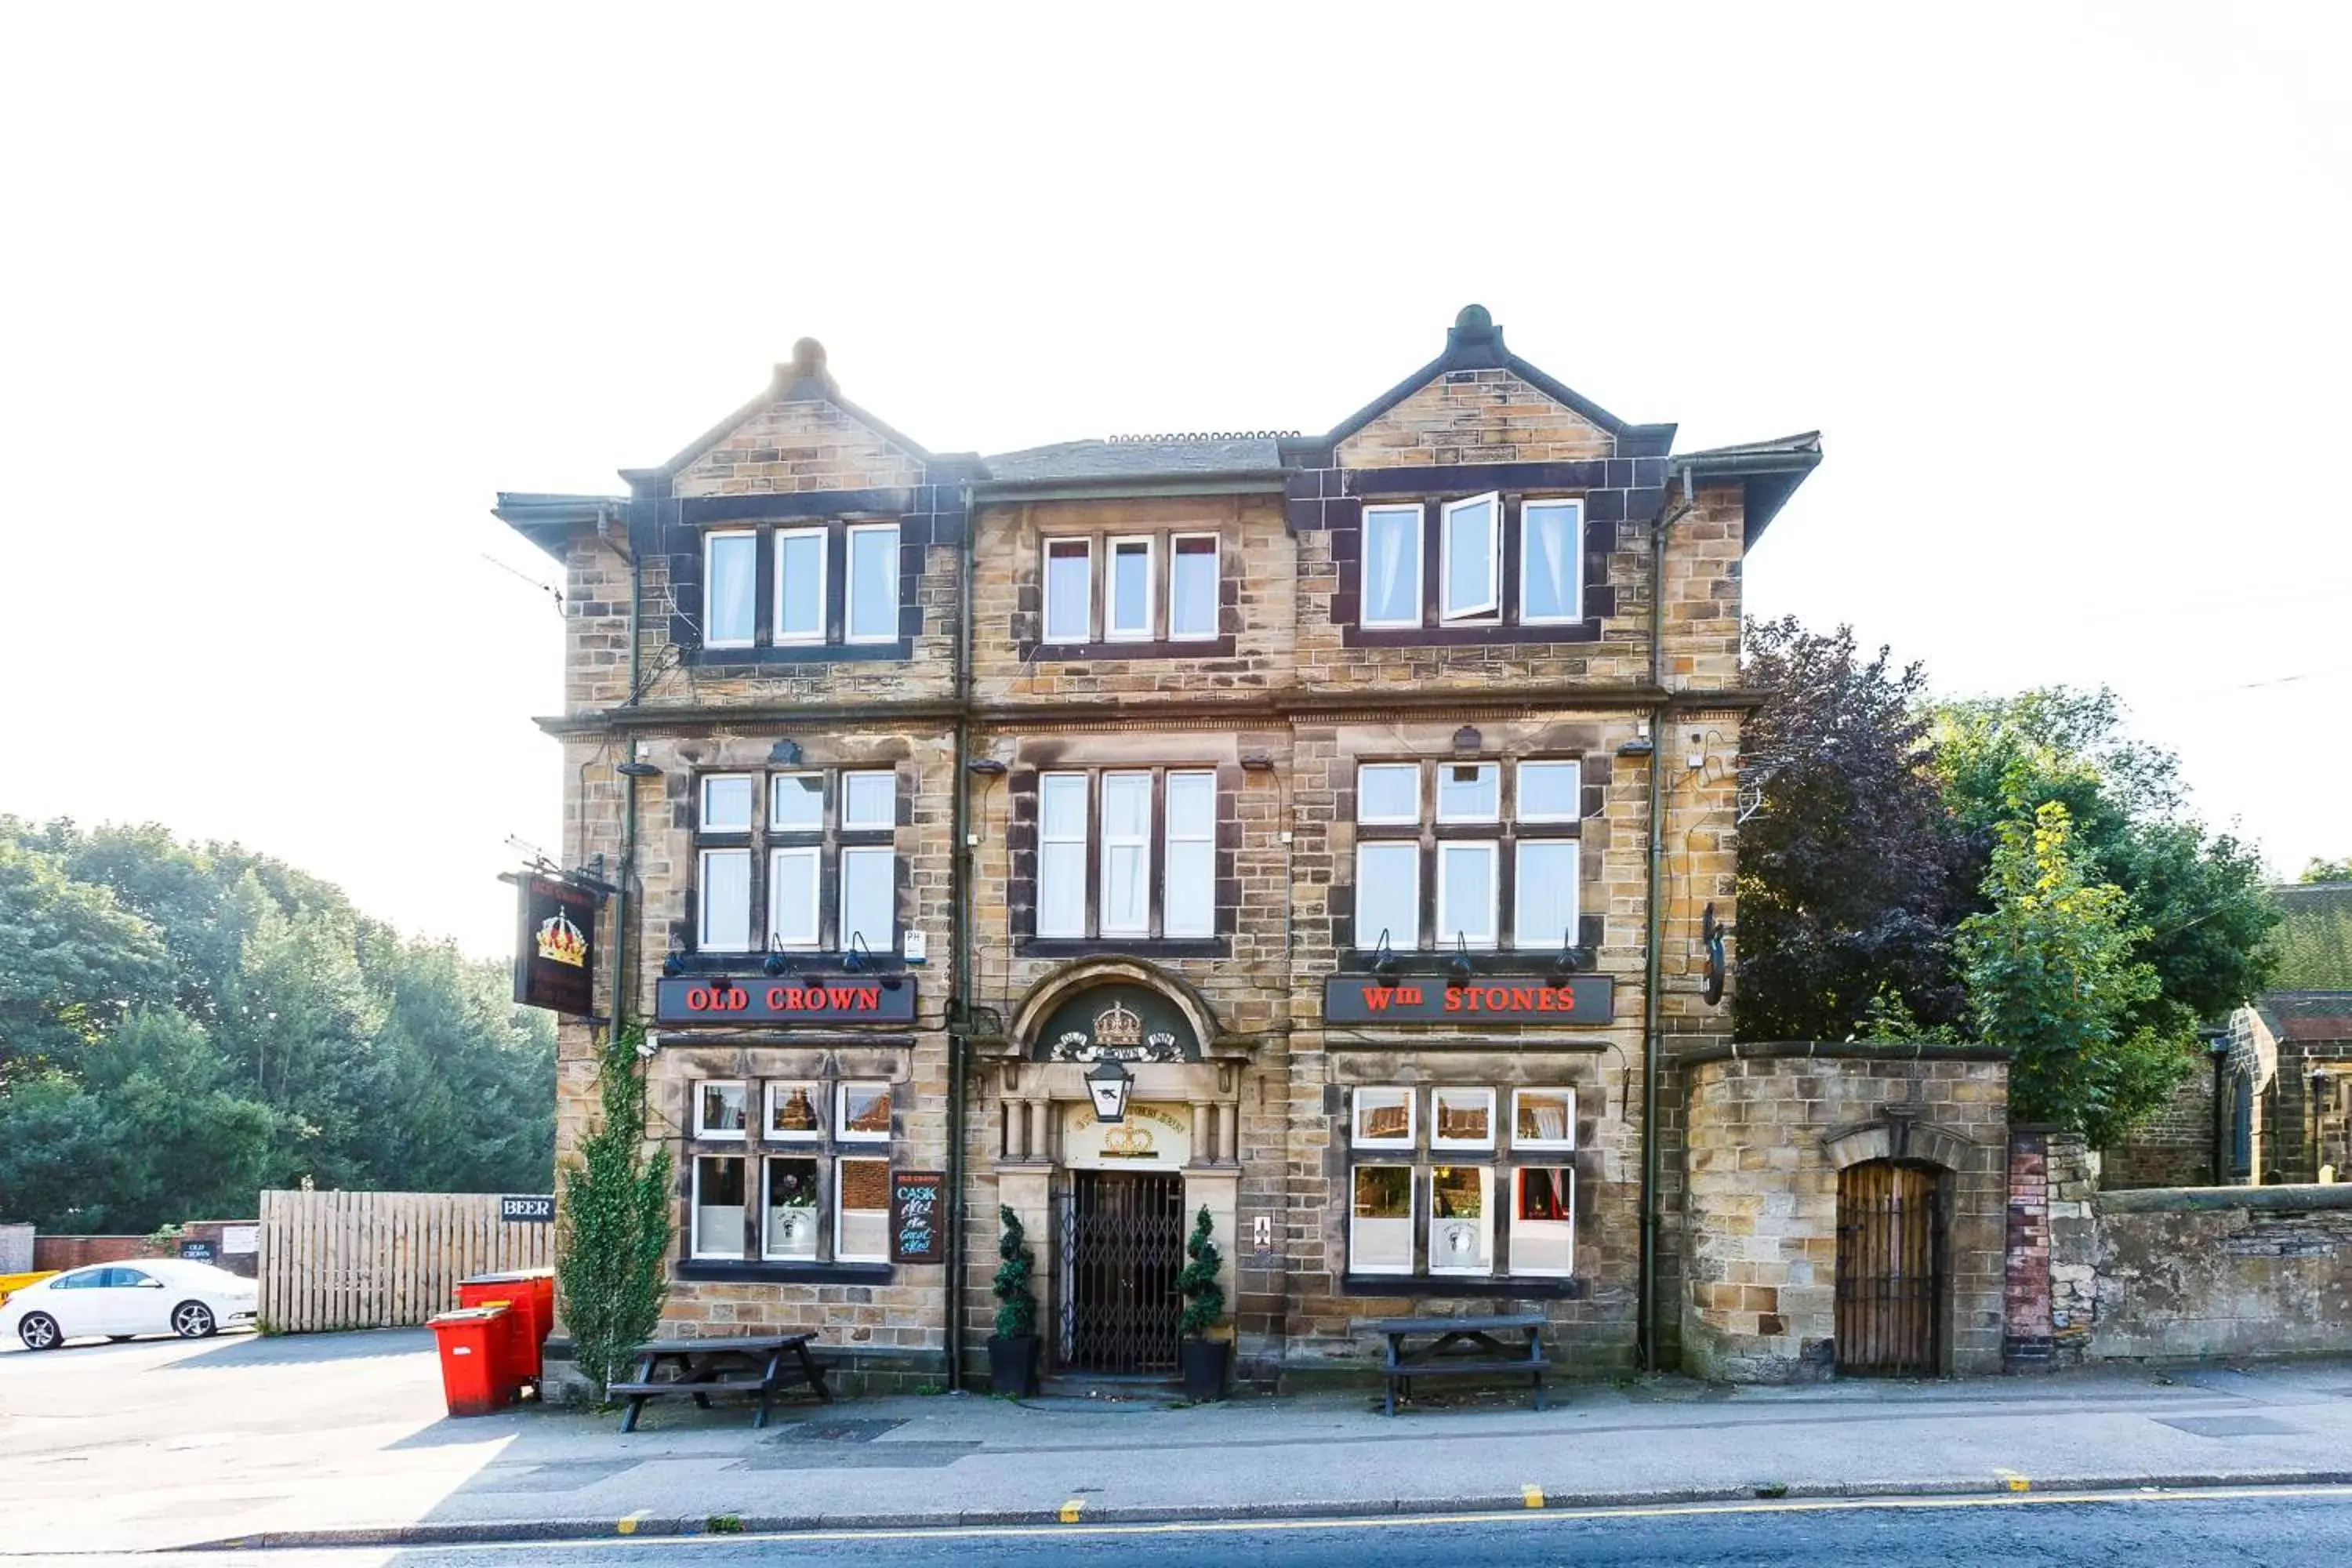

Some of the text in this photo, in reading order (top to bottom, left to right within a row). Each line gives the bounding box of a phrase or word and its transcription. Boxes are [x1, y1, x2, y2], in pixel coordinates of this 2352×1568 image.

[907, 932, 920, 942] PH
[686, 987, 881, 1011] OLD CROWN
[1362, 986, 1576, 1011] Wm STONES
[897, 1186, 938, 1200] CASK
[504, 1200, 550, 1215] BEER
